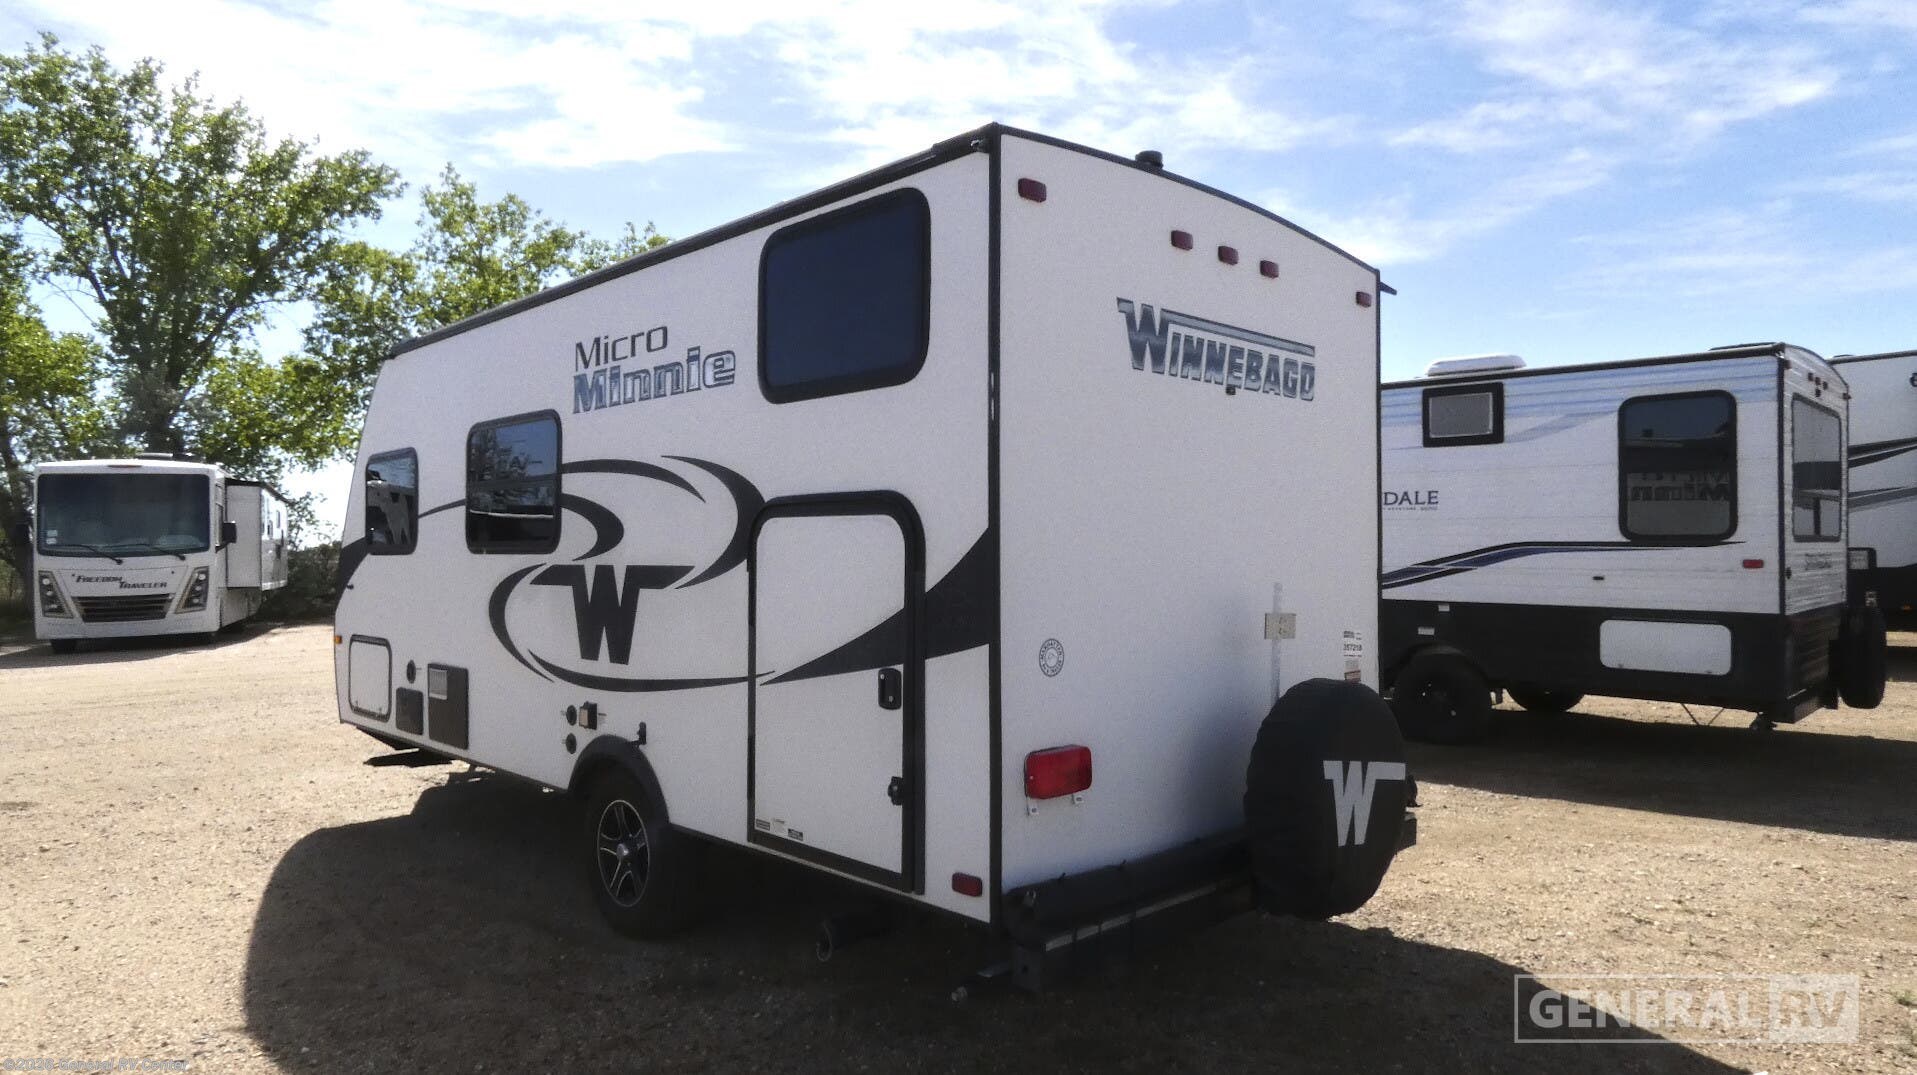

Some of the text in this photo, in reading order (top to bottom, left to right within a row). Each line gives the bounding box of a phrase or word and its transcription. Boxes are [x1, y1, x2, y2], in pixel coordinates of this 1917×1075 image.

[573, 346, 736, 414] Minnie
[576, 326, 668, 372] Micro
[1117, 297, 1315, 401] WINNEBAGO
[76, 575, 123, 583] FREEDOM
[120, 581, 168, 589] TRAVELER
[530, 564, 696, 666] W
[1323, 760, 1406, 847] W
